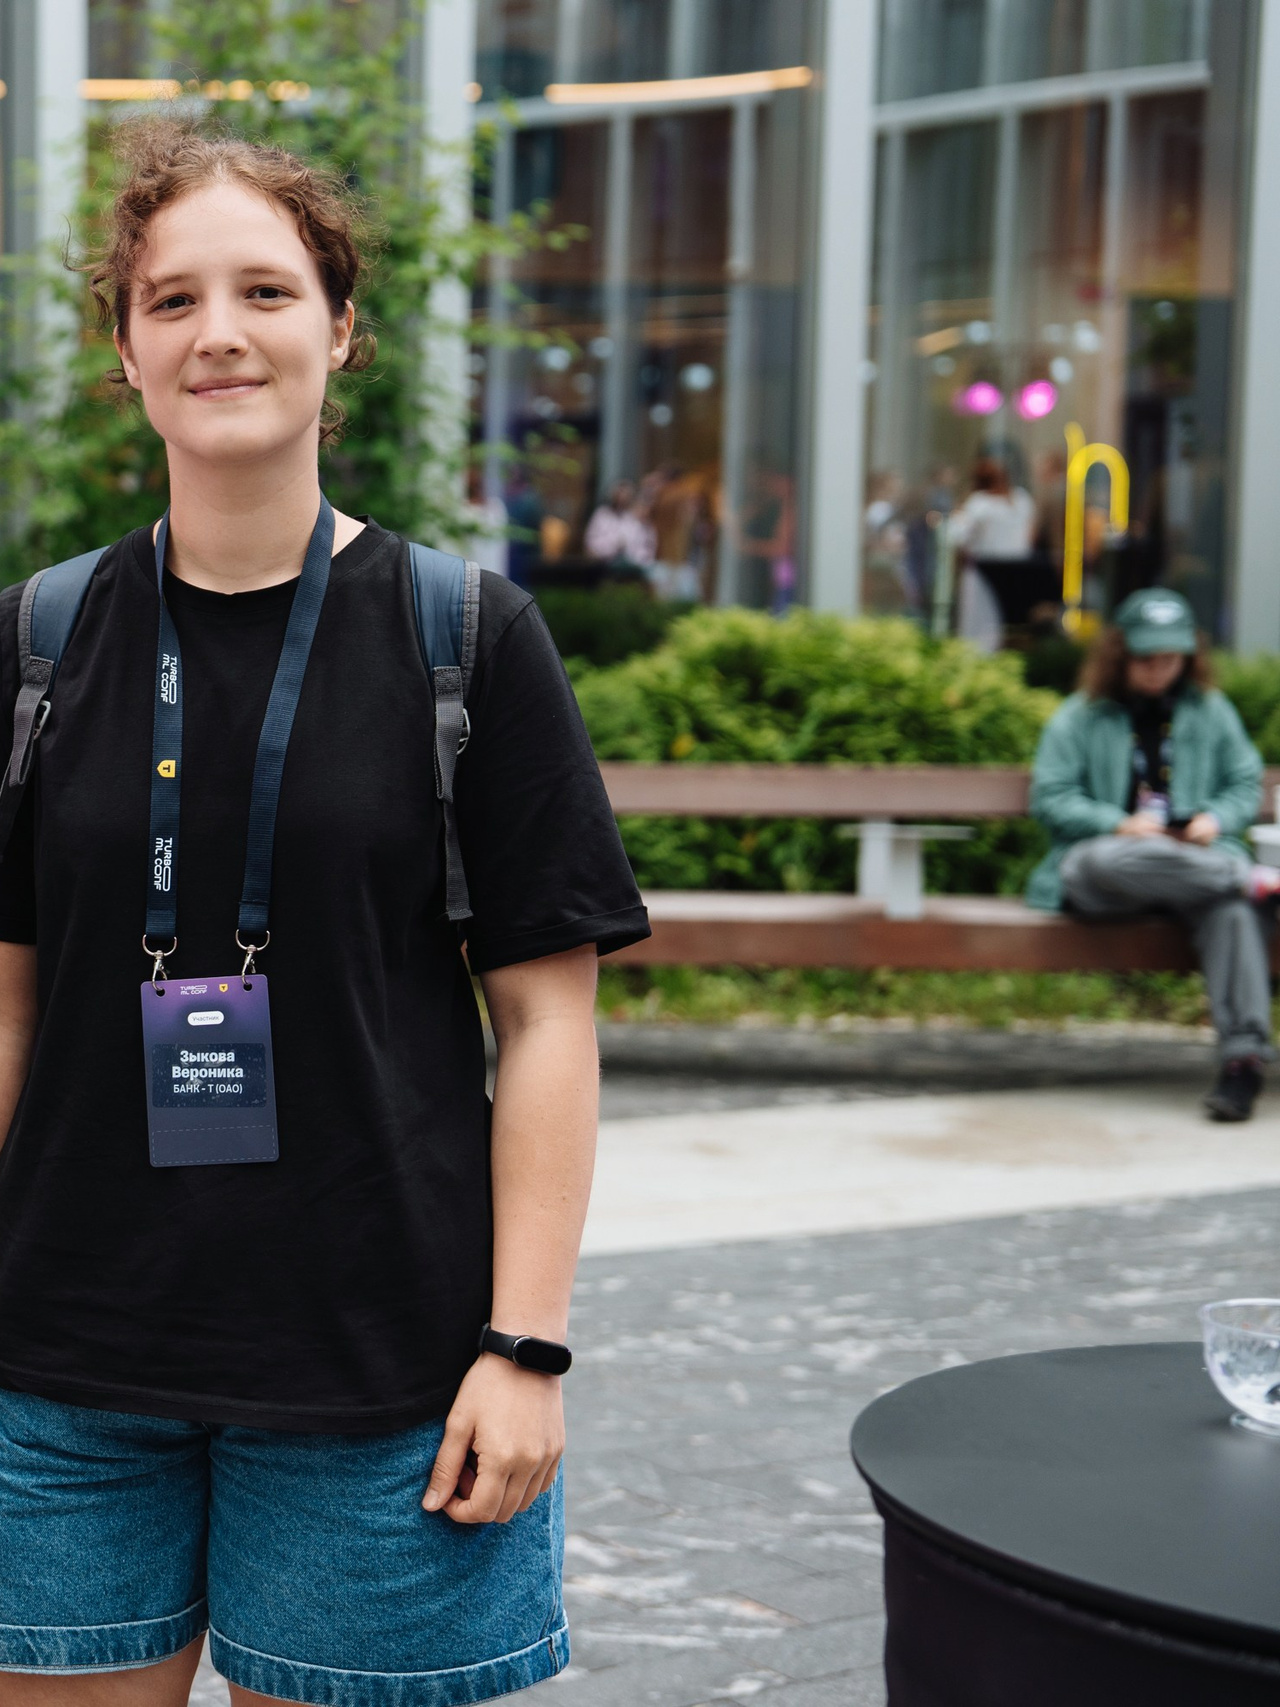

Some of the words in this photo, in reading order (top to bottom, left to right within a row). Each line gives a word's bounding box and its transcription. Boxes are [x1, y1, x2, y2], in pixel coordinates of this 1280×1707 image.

[162, 653, 170, 669] ML
[161, 672, 169, 703] CONF
[169, 656, 178, 704] TURBO
[155, 837, 164, 855] ML
[162, 837, 173, 892] TURBO
[153, 858, 163, 891] CONF
[180, 1050, 235, 1063] Зыкова
[172, 1066, 244, 1081] Вероника
[173, 1083, 200, 1094] БАНК
[215, 1083, 243, 1095] (ОАО)
